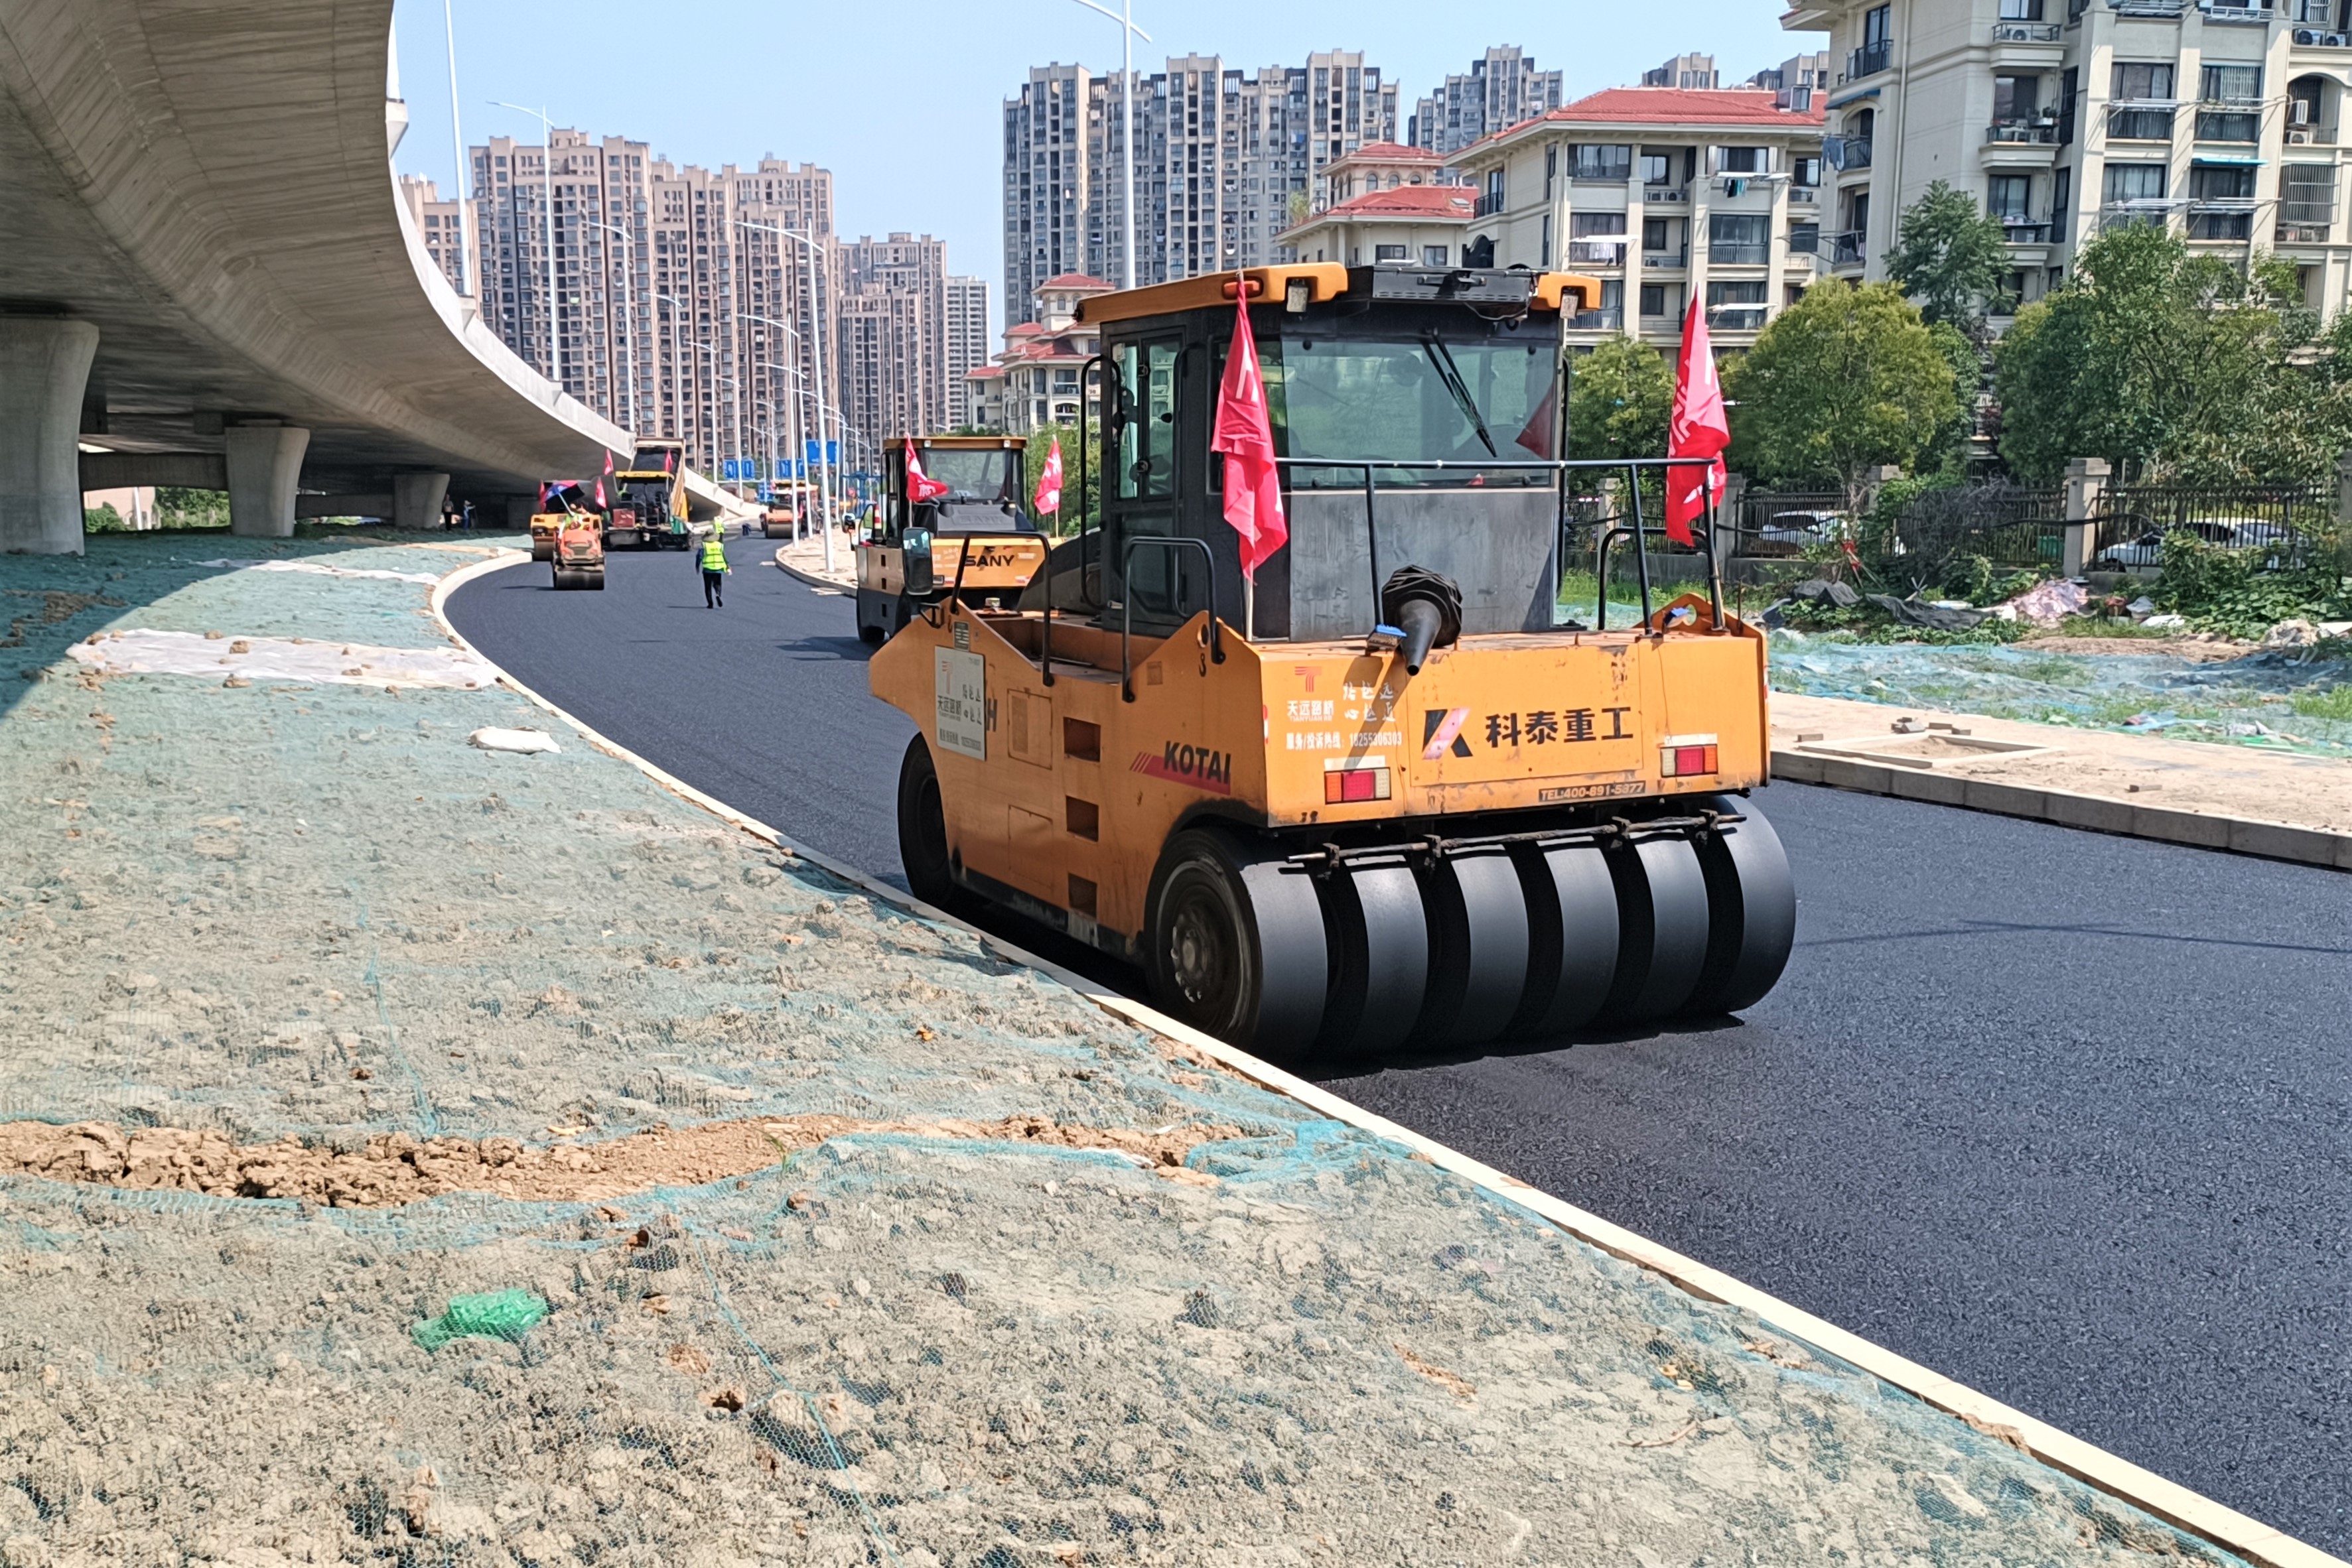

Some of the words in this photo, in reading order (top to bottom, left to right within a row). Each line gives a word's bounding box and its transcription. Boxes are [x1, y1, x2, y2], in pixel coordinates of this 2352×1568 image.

[965, 555, 1014, 567] SANY
[1287, 700, 1334, 716] 天远路桥
[1486, 707, 1633, 748] 科泰重工
[1164, 740, 1231, 785] KOTAI
